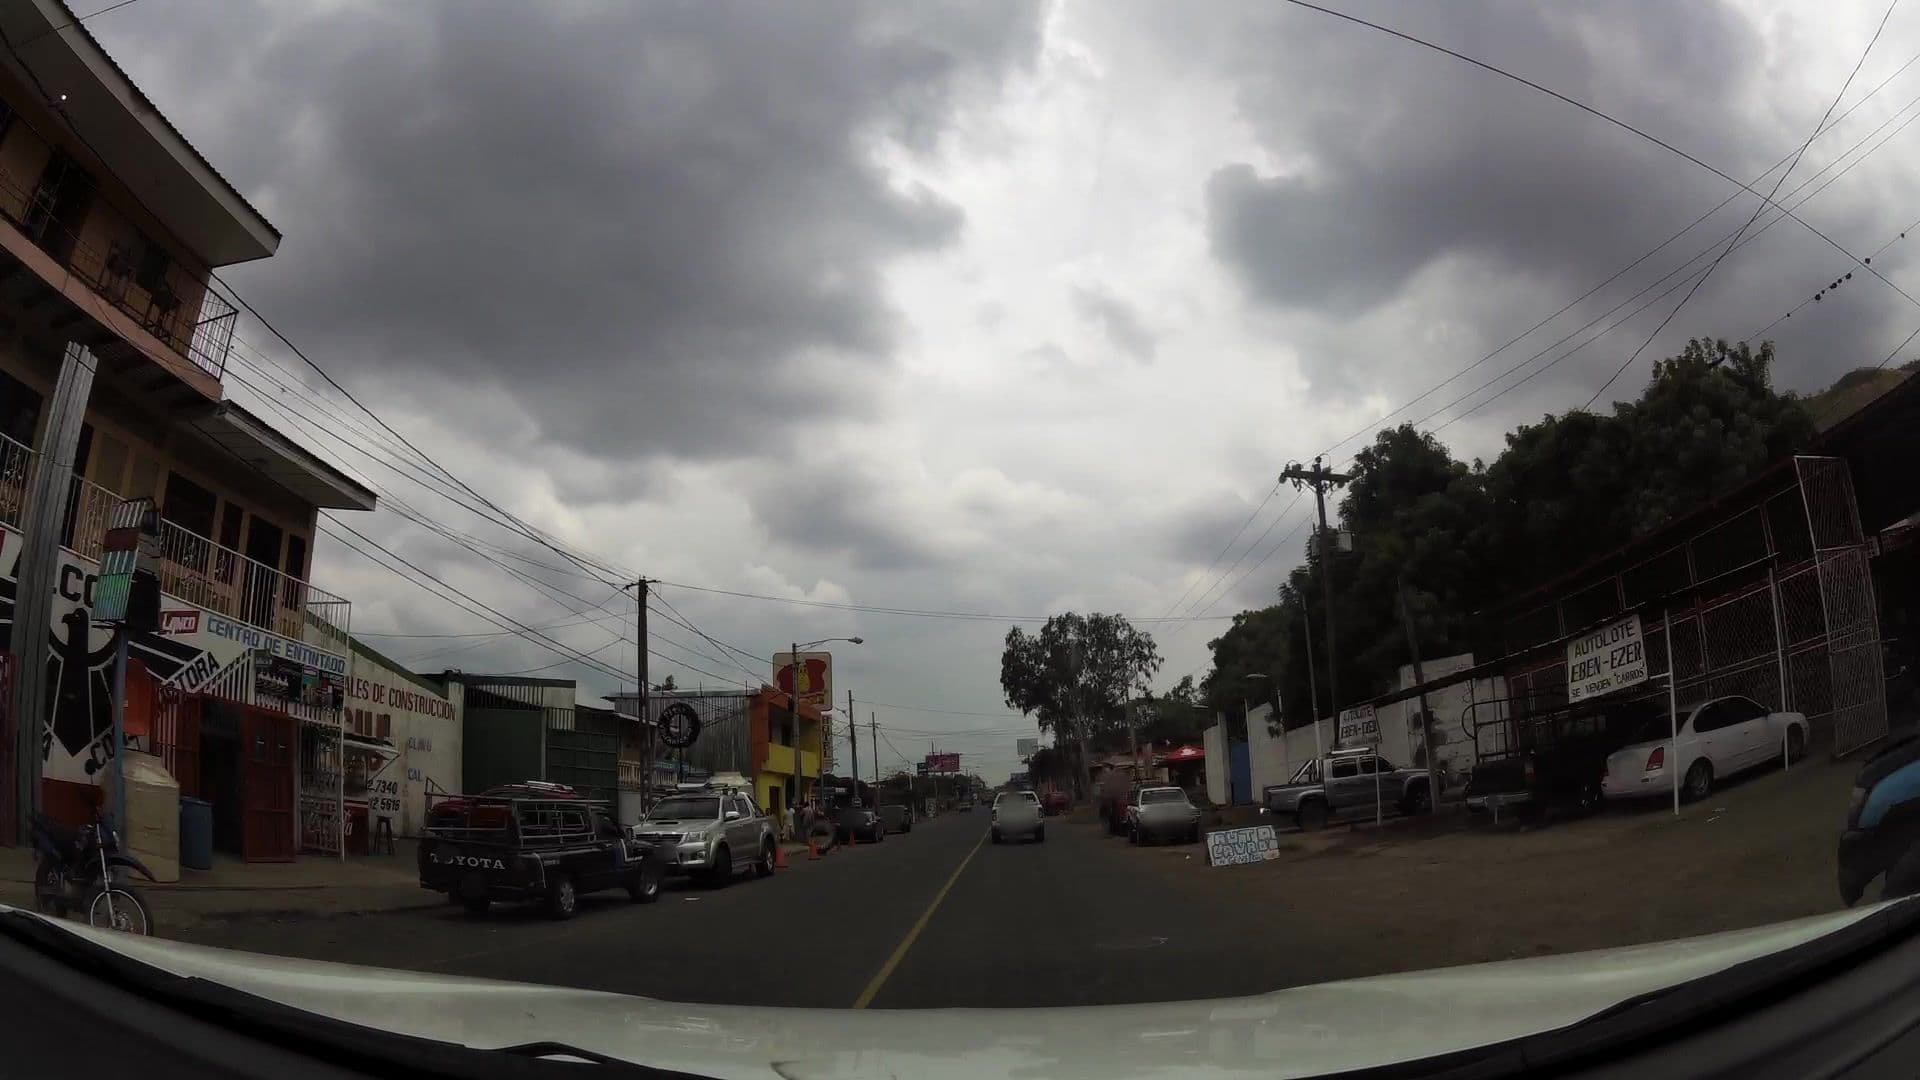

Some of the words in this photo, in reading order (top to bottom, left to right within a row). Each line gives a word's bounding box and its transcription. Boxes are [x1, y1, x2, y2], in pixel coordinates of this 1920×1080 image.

[207, 616, 259, 647] CENTRO
[264, 635, 281, 655] DE
[286, 642, 345, 675] ENTINTADO
[1574, 621, 1635, 658] AUTOLOTE
[172, 652, 219, 692] TORA
[1571, 641, 1642, 683] EBEN-EZER
[345, 675, 369, 700] ALES
[373, 682, 385, 704] DE
[388, 688, 456, 722] CONSTRUCCION
[1572, 688, 1581, 698] SE
